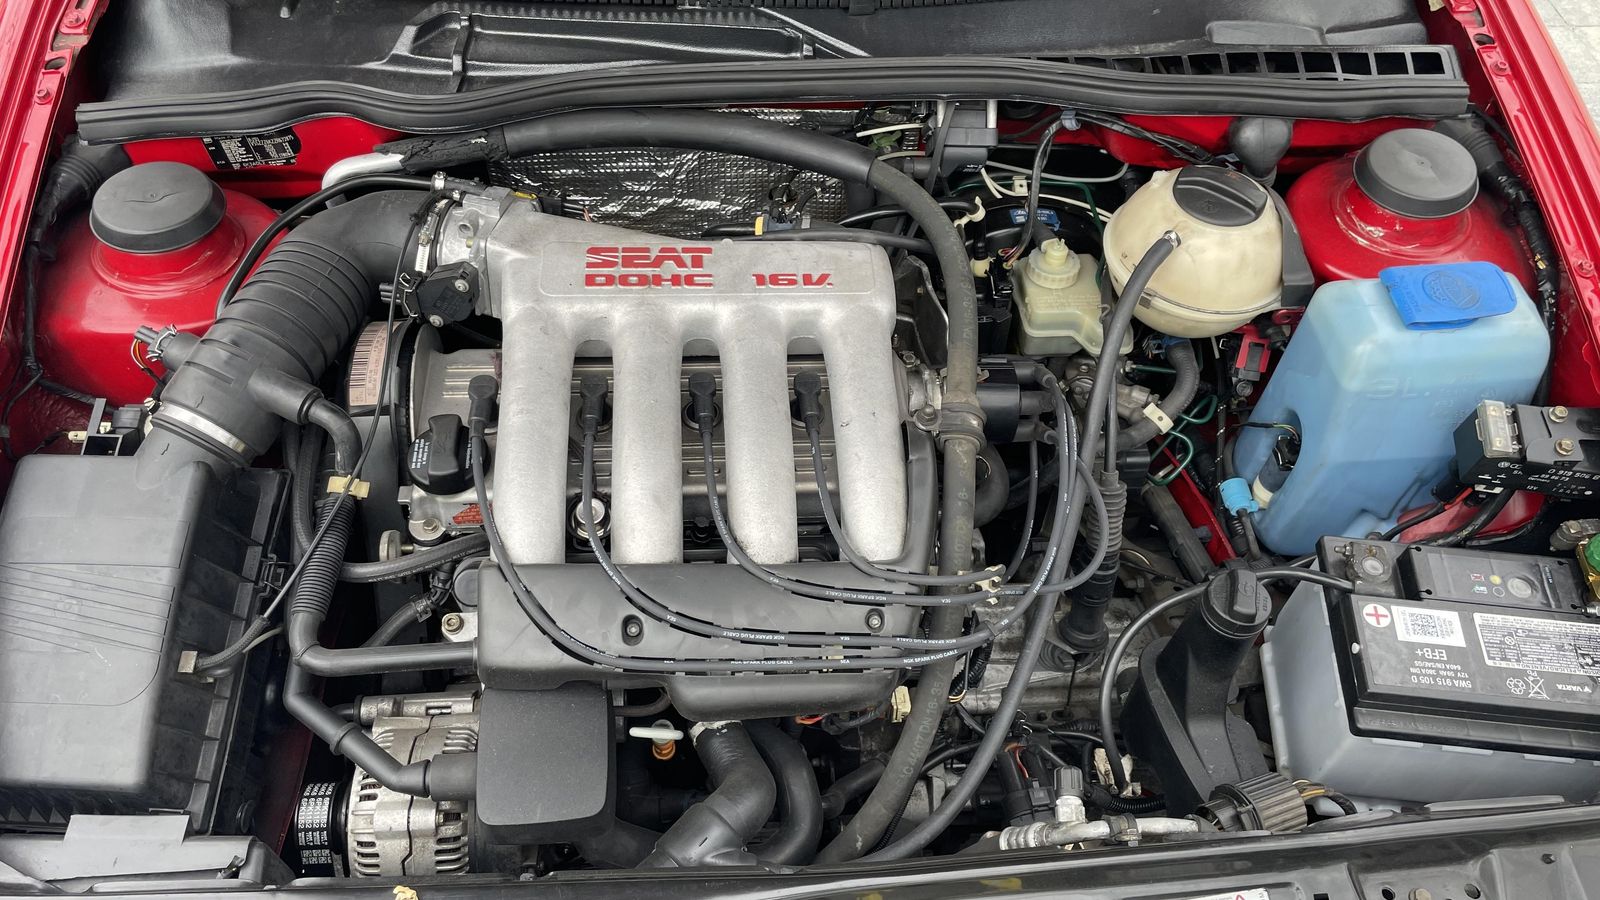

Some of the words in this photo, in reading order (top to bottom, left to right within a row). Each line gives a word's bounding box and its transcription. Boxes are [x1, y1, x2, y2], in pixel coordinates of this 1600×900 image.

[585, 246, 713, 271] SEAT
[584, 273, 714, 289] DOHC
[943, 649, 958, 657] CABLE
[1415, 648, 1447, 660] EFB+
[1411, 675, 1418, 683] D
[1419, 676, 1435, 684] 105
[1436, 677, 1452, 687] 915
[1453, 679, 1472, 688] 5WA
[1556, 683, 1583, 692] VARTA
[305, 797, 316, 829] 6PK1152
